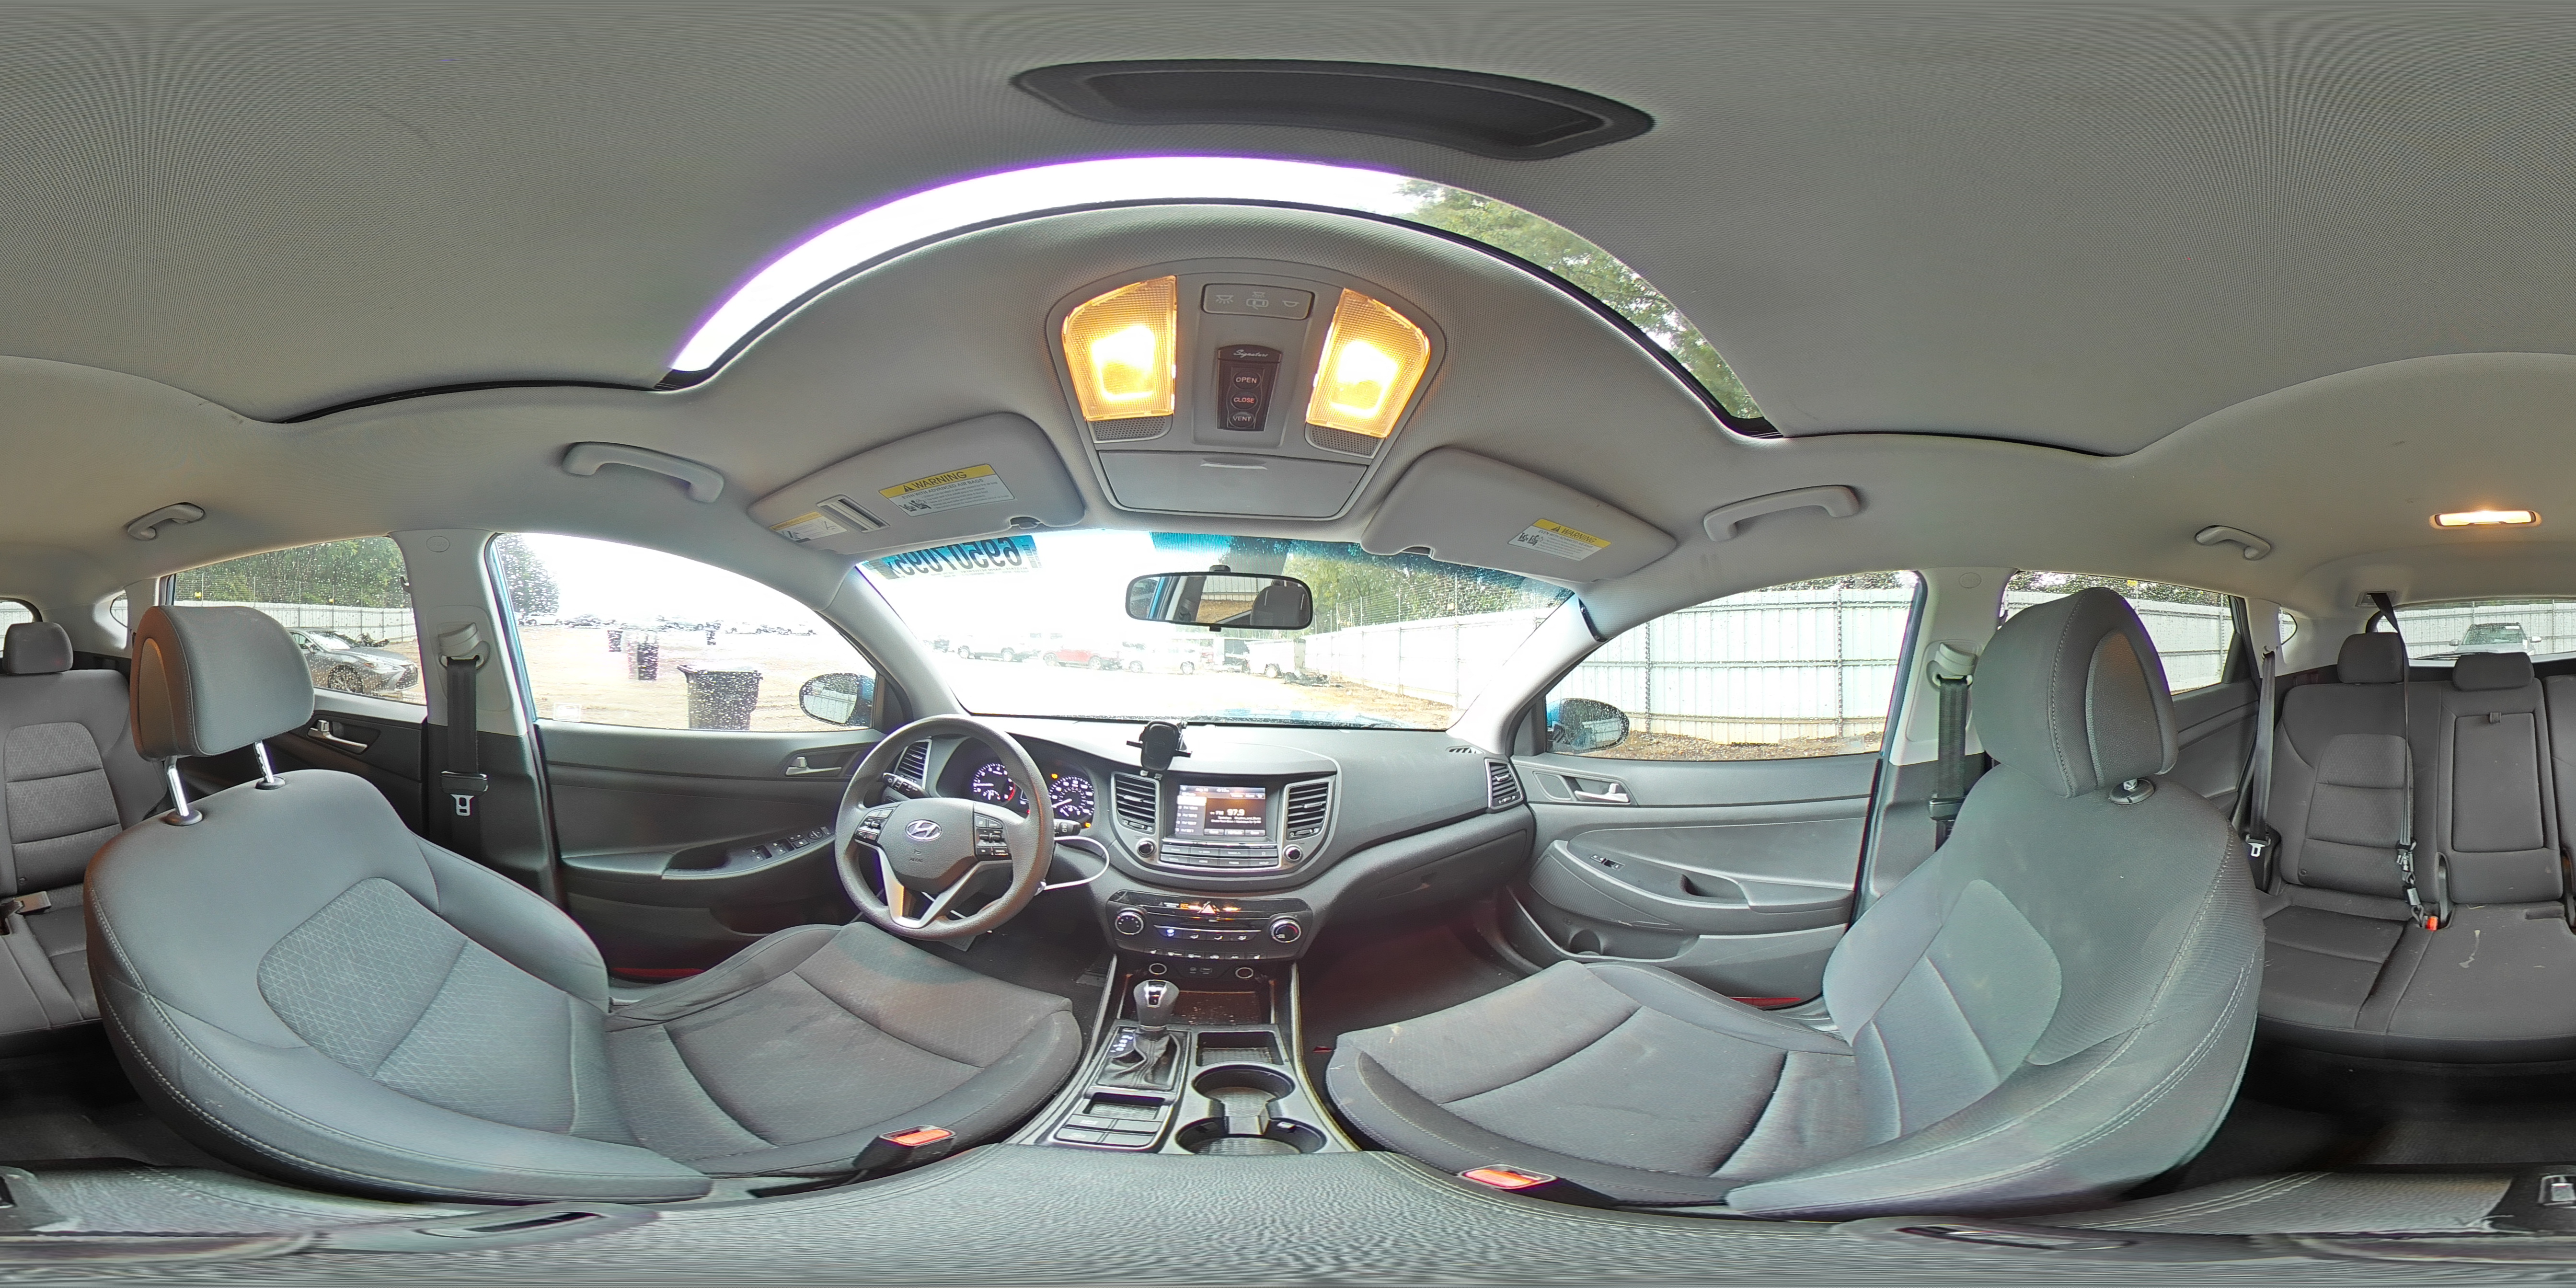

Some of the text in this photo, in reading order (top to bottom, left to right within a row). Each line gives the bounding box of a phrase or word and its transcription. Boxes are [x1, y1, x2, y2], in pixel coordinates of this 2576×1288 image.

[912, 471, 967, 489] WARNING
[928, 484, 957, 493] ADVANCED
[1561, 528, 1597, 543] WARNING
